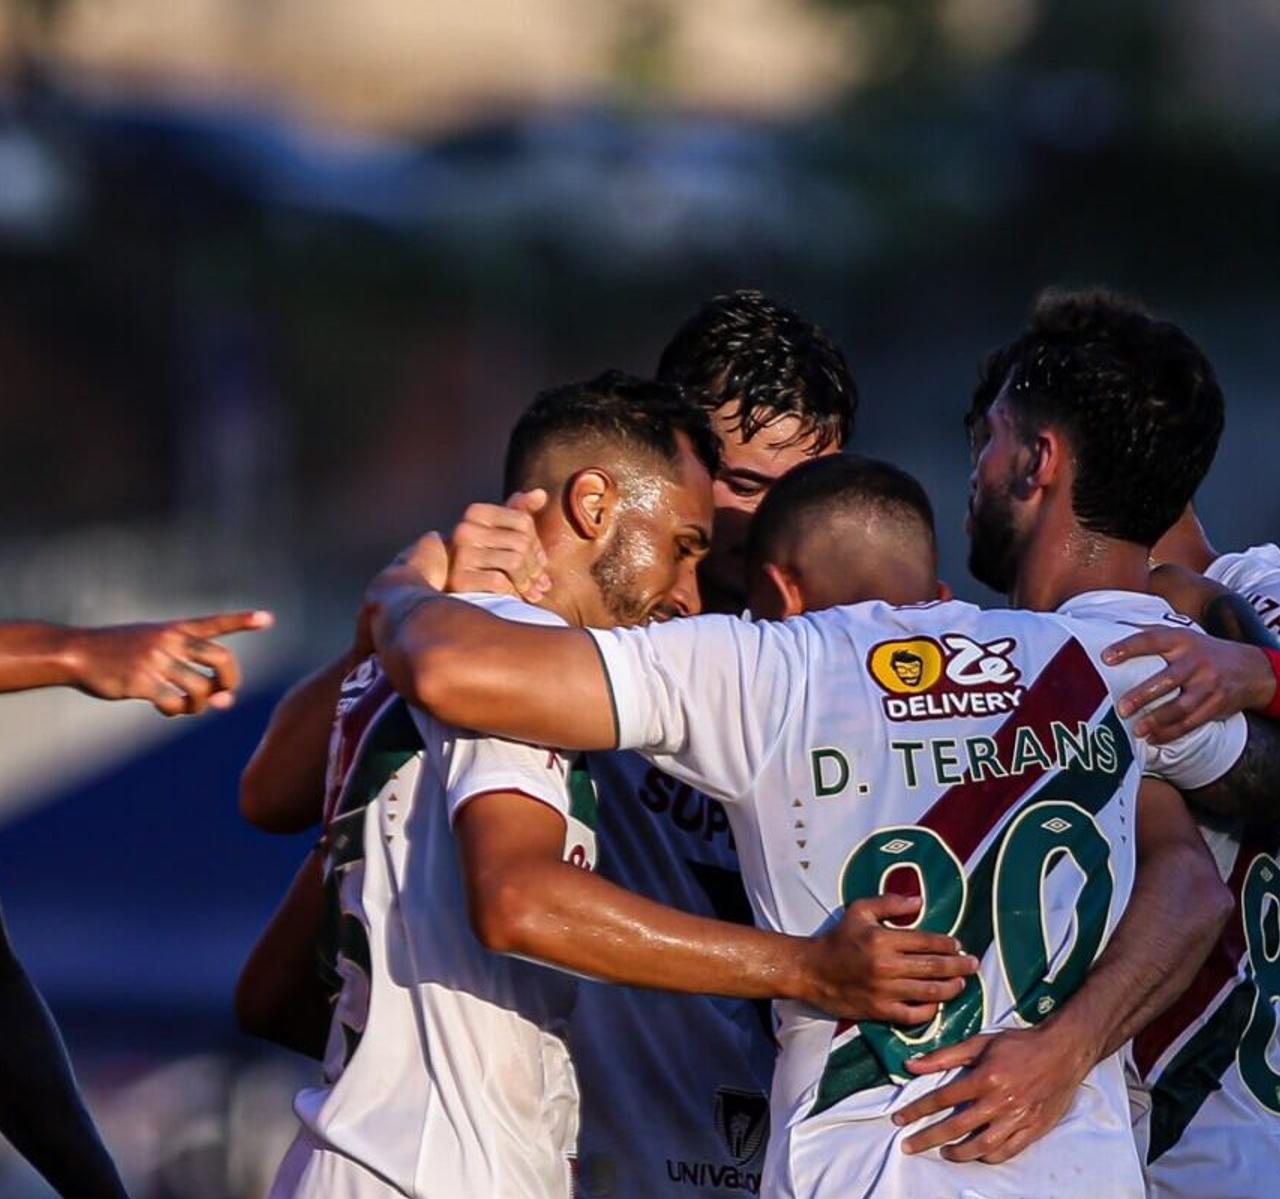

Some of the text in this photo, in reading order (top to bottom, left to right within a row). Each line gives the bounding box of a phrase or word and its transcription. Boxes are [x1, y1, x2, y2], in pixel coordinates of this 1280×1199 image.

[887, 689, 1022, 718] DELIVERY
[810, 718, 1118, 798] D. TERANS
